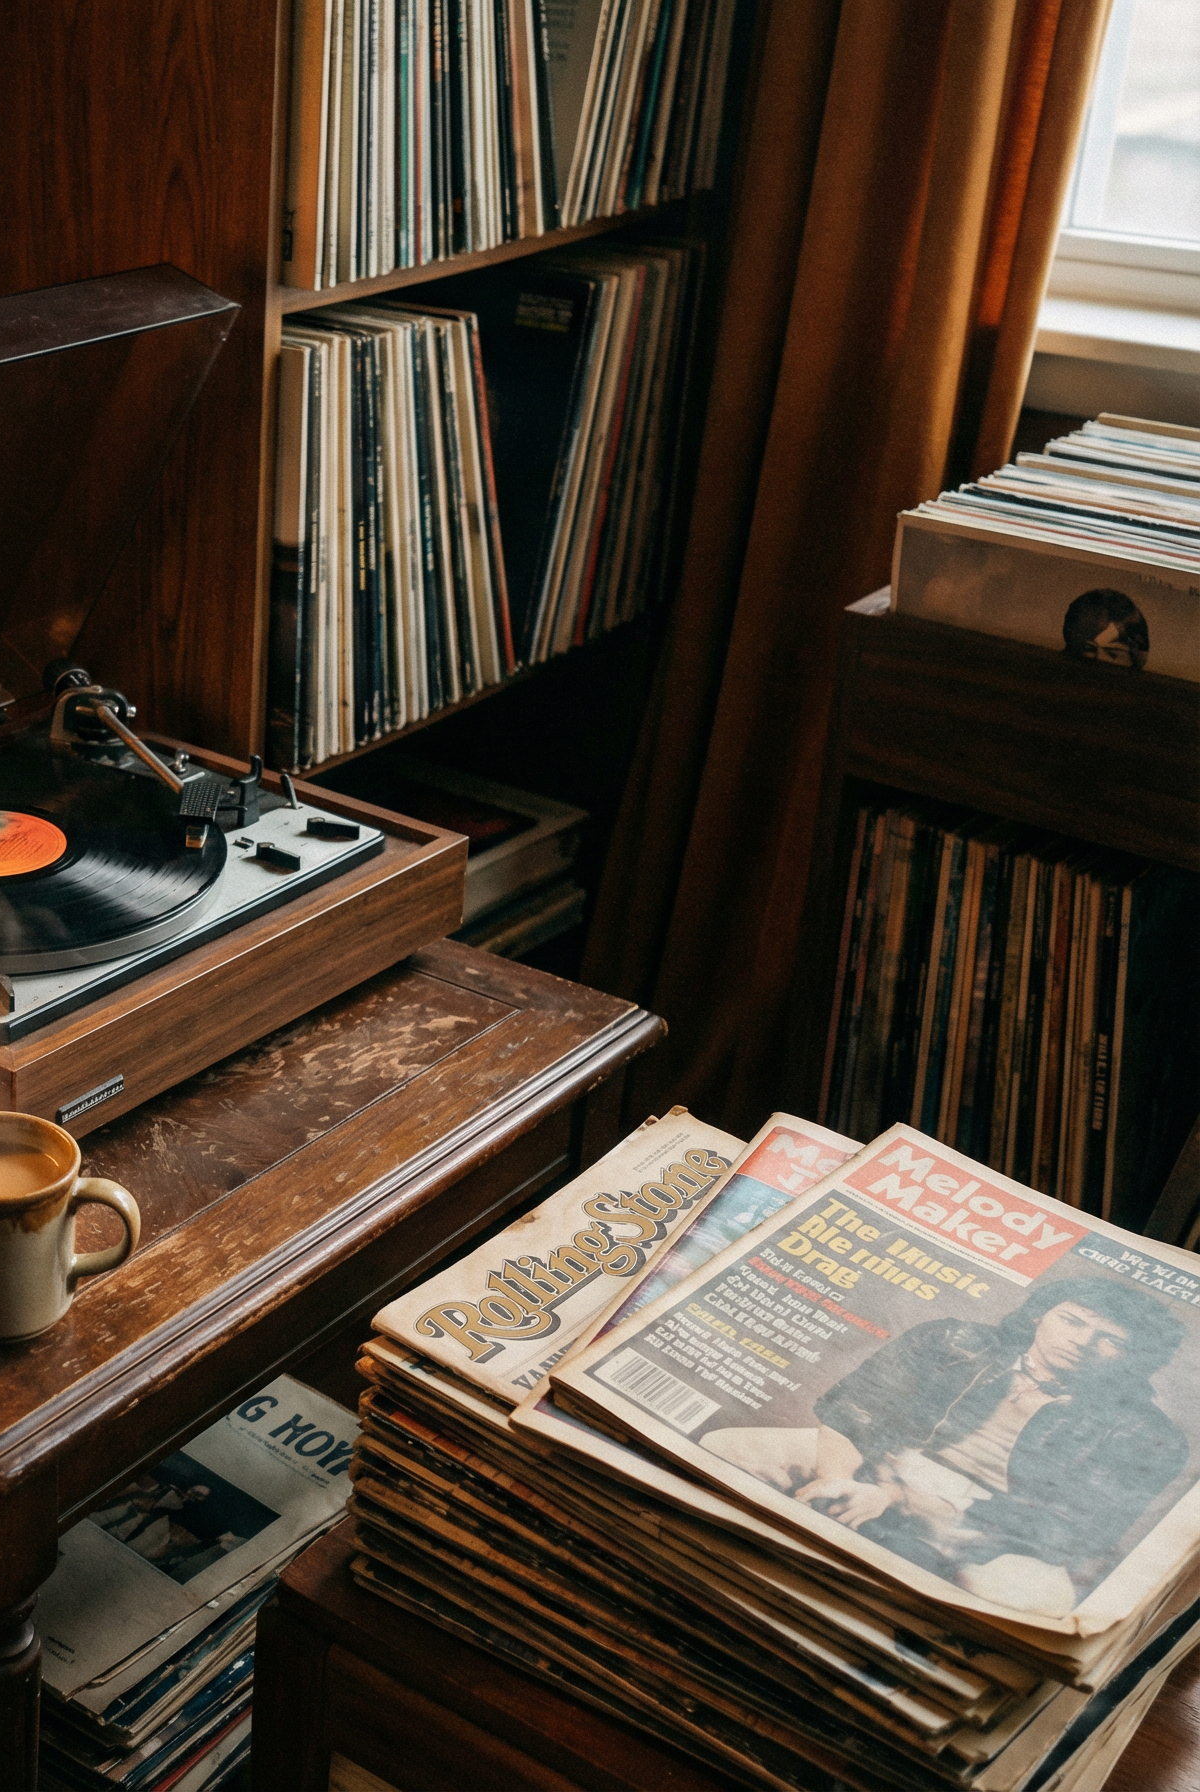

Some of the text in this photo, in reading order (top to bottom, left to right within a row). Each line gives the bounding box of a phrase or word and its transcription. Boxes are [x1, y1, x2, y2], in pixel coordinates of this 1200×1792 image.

[819, 1197, 881, 1243] The
[865, 1172, 1030, 1261] Maker
[877, 1144, 1075, 1250] Melody
[414, 1221, 646, 1363] Rolling
[581, 1148, 732, 1249] Stone
[776, 1231, 861, 1290] Drag
